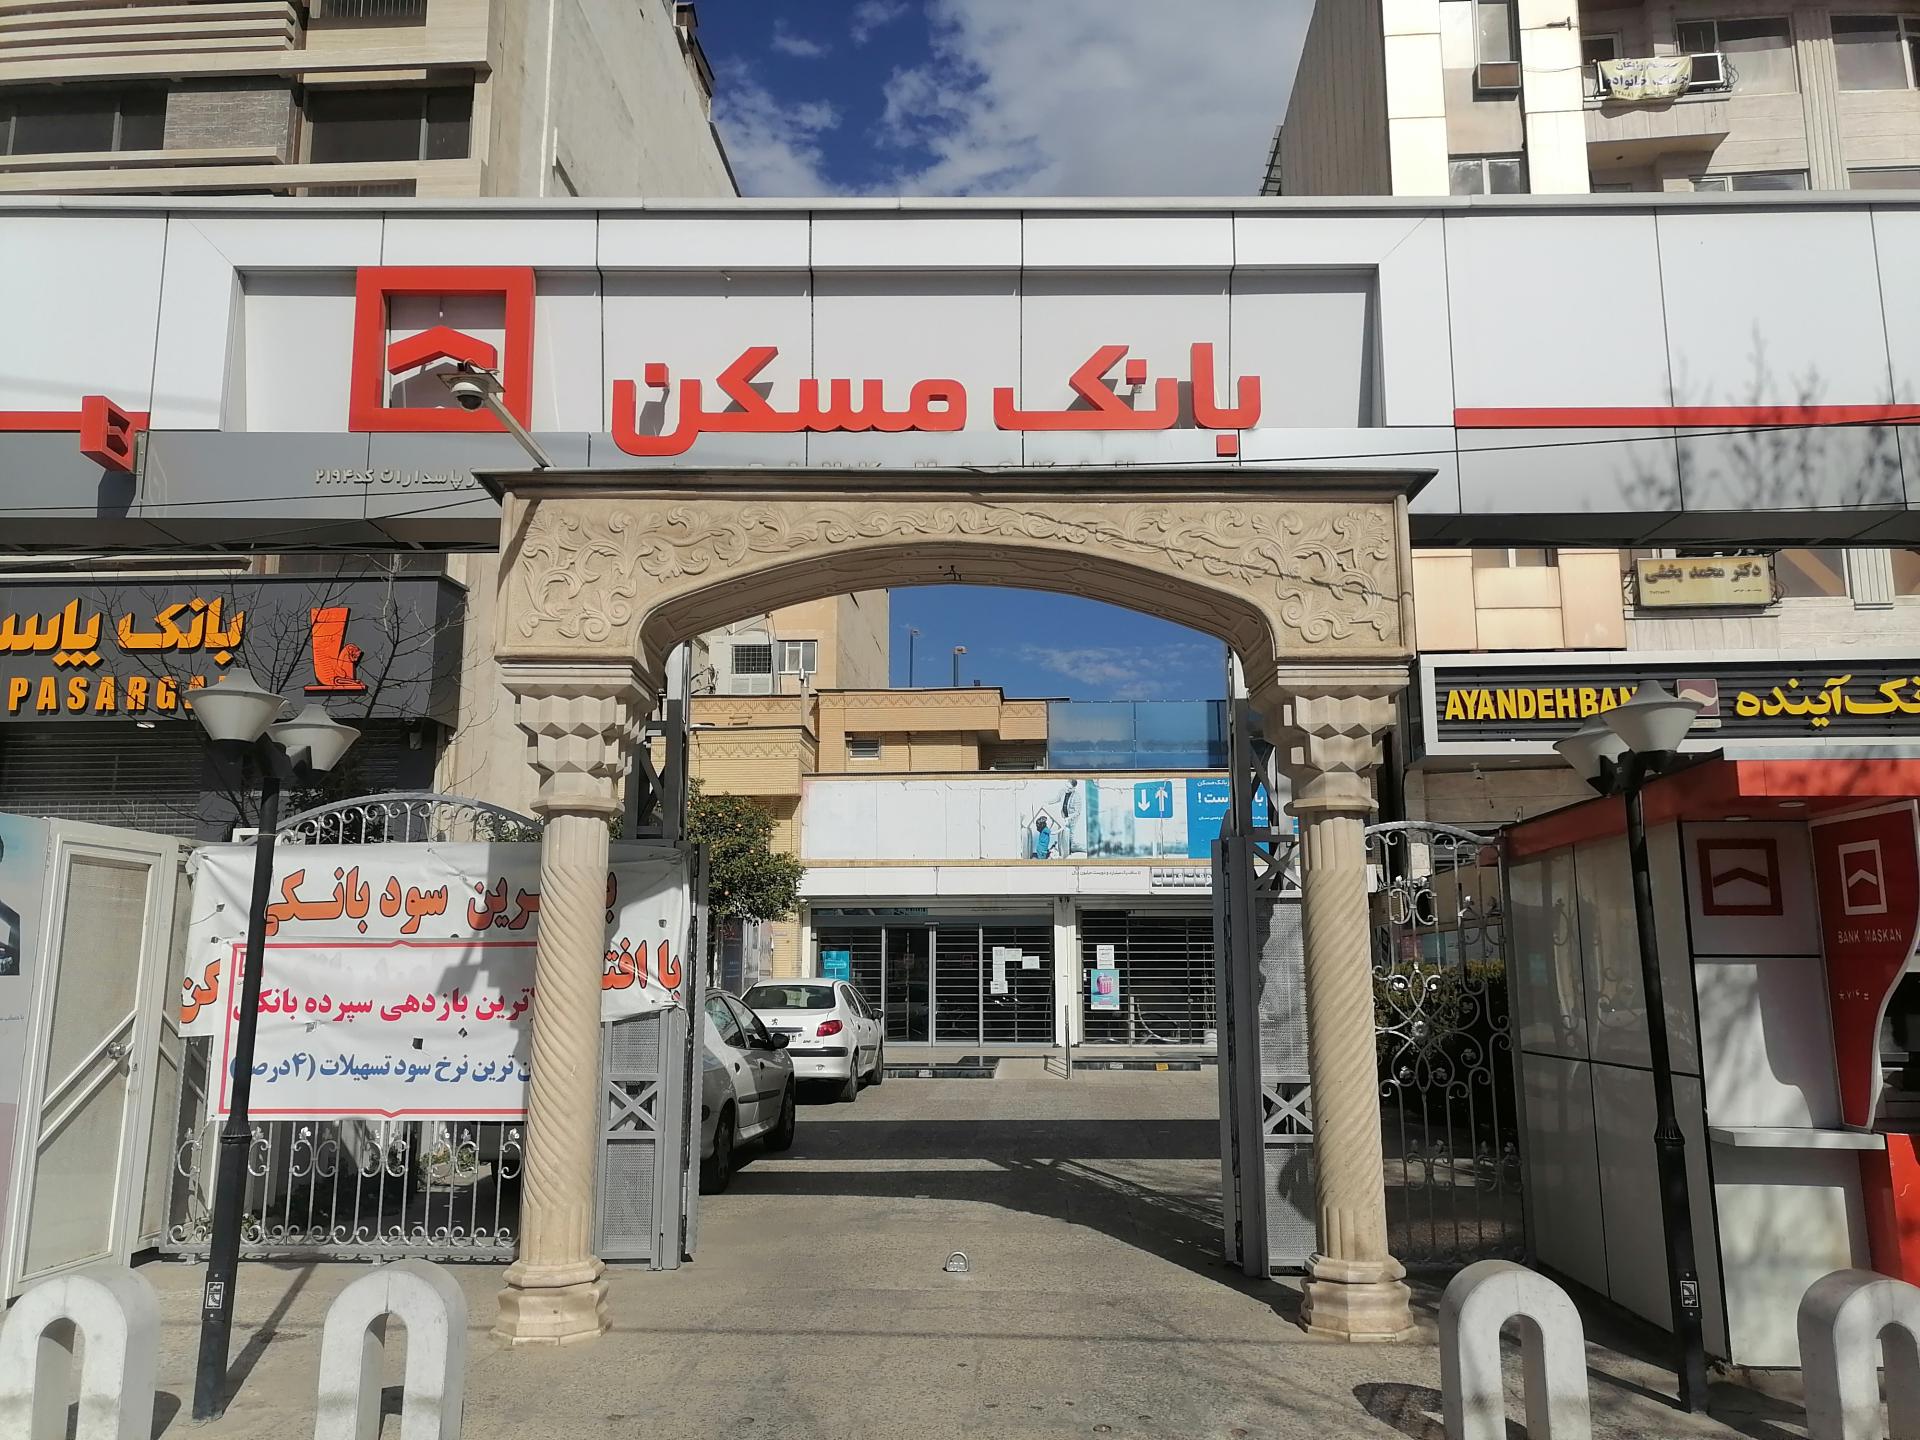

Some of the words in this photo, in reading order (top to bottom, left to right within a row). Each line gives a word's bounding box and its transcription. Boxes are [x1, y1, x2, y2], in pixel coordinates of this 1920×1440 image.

[611, 346, 968, 457] مسکن
[992, 342, 1262, 457] بانک
[380, 468, 463, 490] پاسداران
[1689, 566, 1725, 579] محمد
[1730, 561, 1762, 583] دکتر
[118, 596, 247, 667] بانک
[8, 675, 229, 712] PASARGA
[1735, 674, 1852, 727] آینده
[1845, 675, 1920, 716] نک
[264, 865, 371, 937] بانکی
[380, 875, 448, 935] سود
[1837, 929, 1860, 944] BANK
[1864, 928, 1903, 944] MASKAN
[305, 994, 373, 1022] سپرده
[380, 987, 468, 1021] بازدهی
[319, 1053, 389, 1081] تسهیلات
[394, 1058, 431, 1082] سود
[434, 1054, 468, 1082] نرخ
[472, 1054, 515, 1082] ترین
